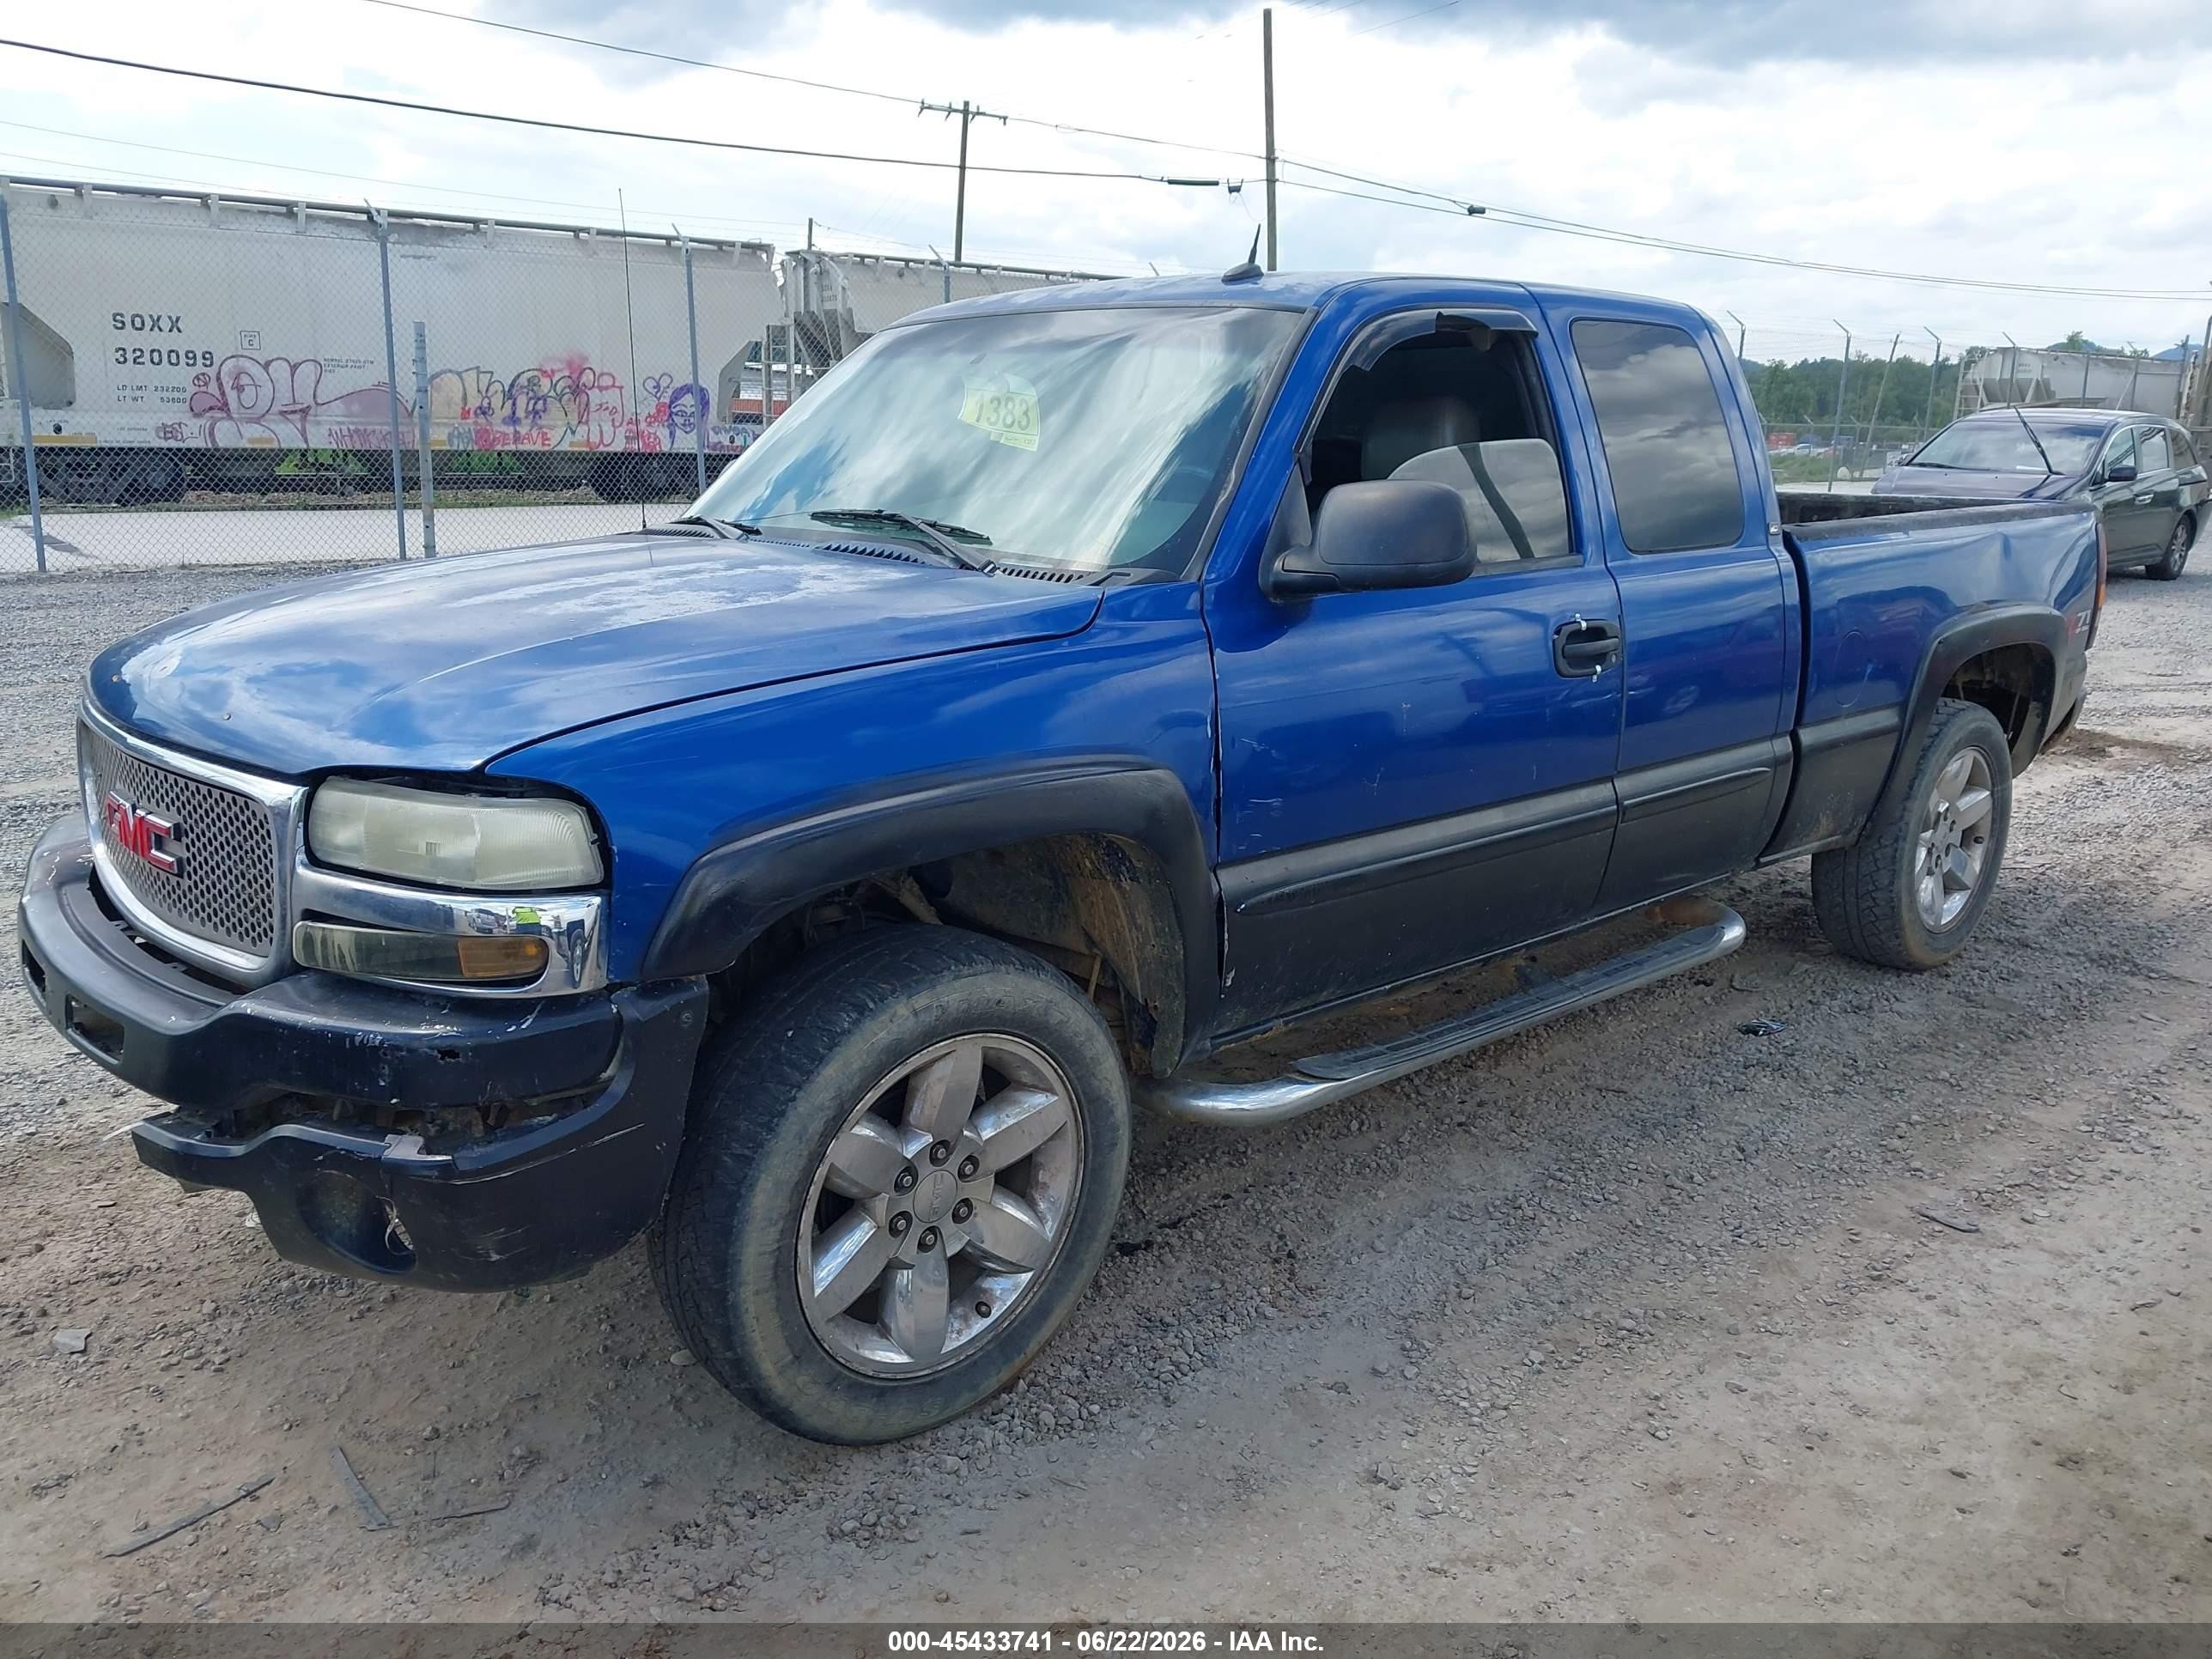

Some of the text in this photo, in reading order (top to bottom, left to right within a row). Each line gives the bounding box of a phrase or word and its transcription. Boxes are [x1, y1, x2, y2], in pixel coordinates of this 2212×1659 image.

[112, 312, 183, 333] SOXX
[114, 346, 215, 368] 320099
[154, 385, 187, 393] 232200
[975, 394, 1030, 431] 1383
